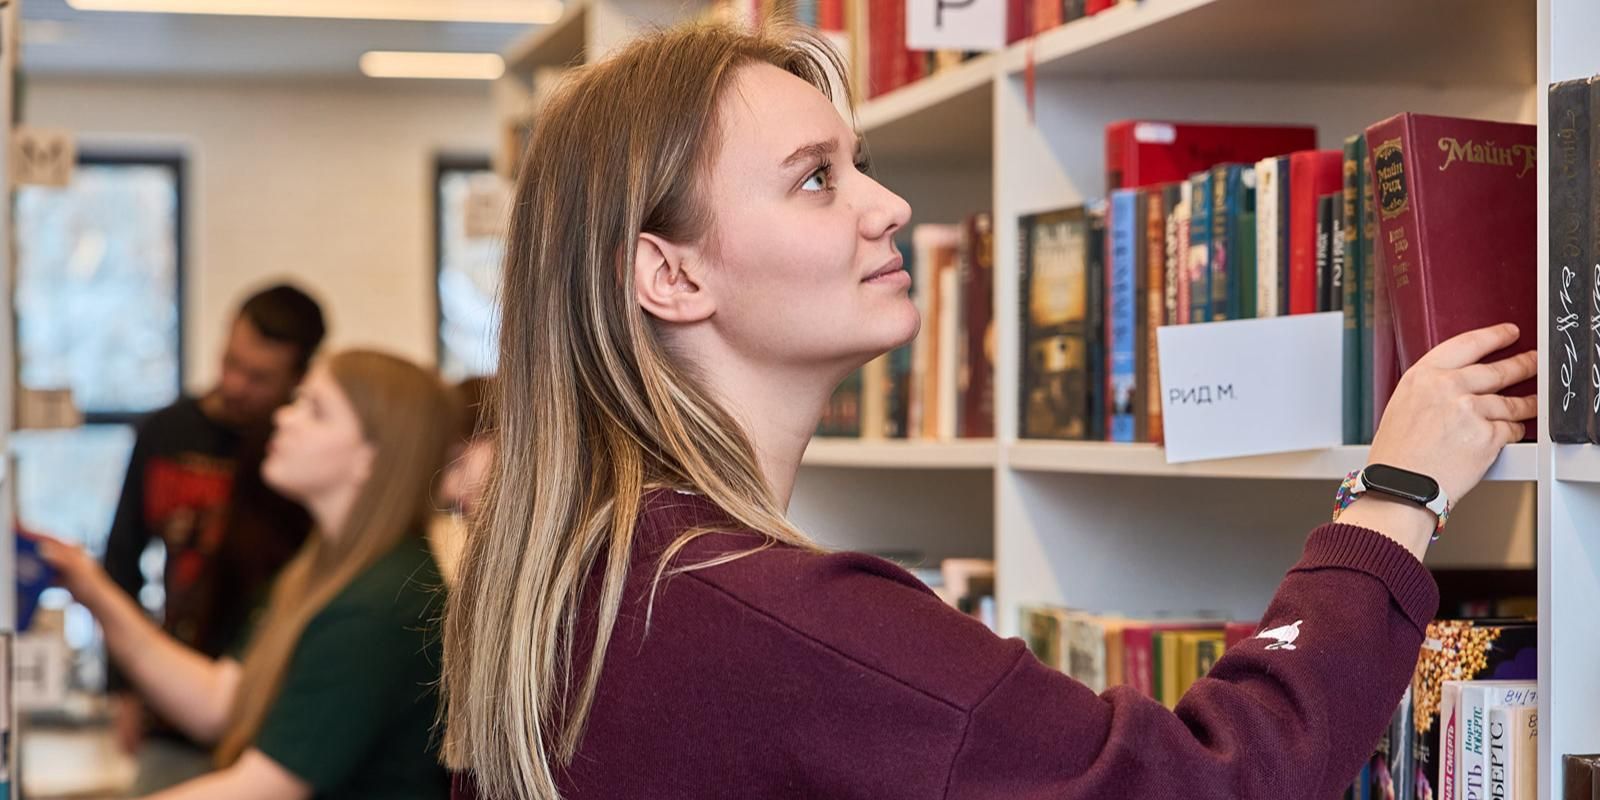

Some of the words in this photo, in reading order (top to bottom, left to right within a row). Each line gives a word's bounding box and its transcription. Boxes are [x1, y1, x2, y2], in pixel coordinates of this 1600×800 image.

[1438, 137, 1513, 171] Майн
[1169, 387, 1213, 405] РИД
[1505, 689, 1537, 705] 84/7
[1447, 725, 1455, 775] СМЕРТЬ
